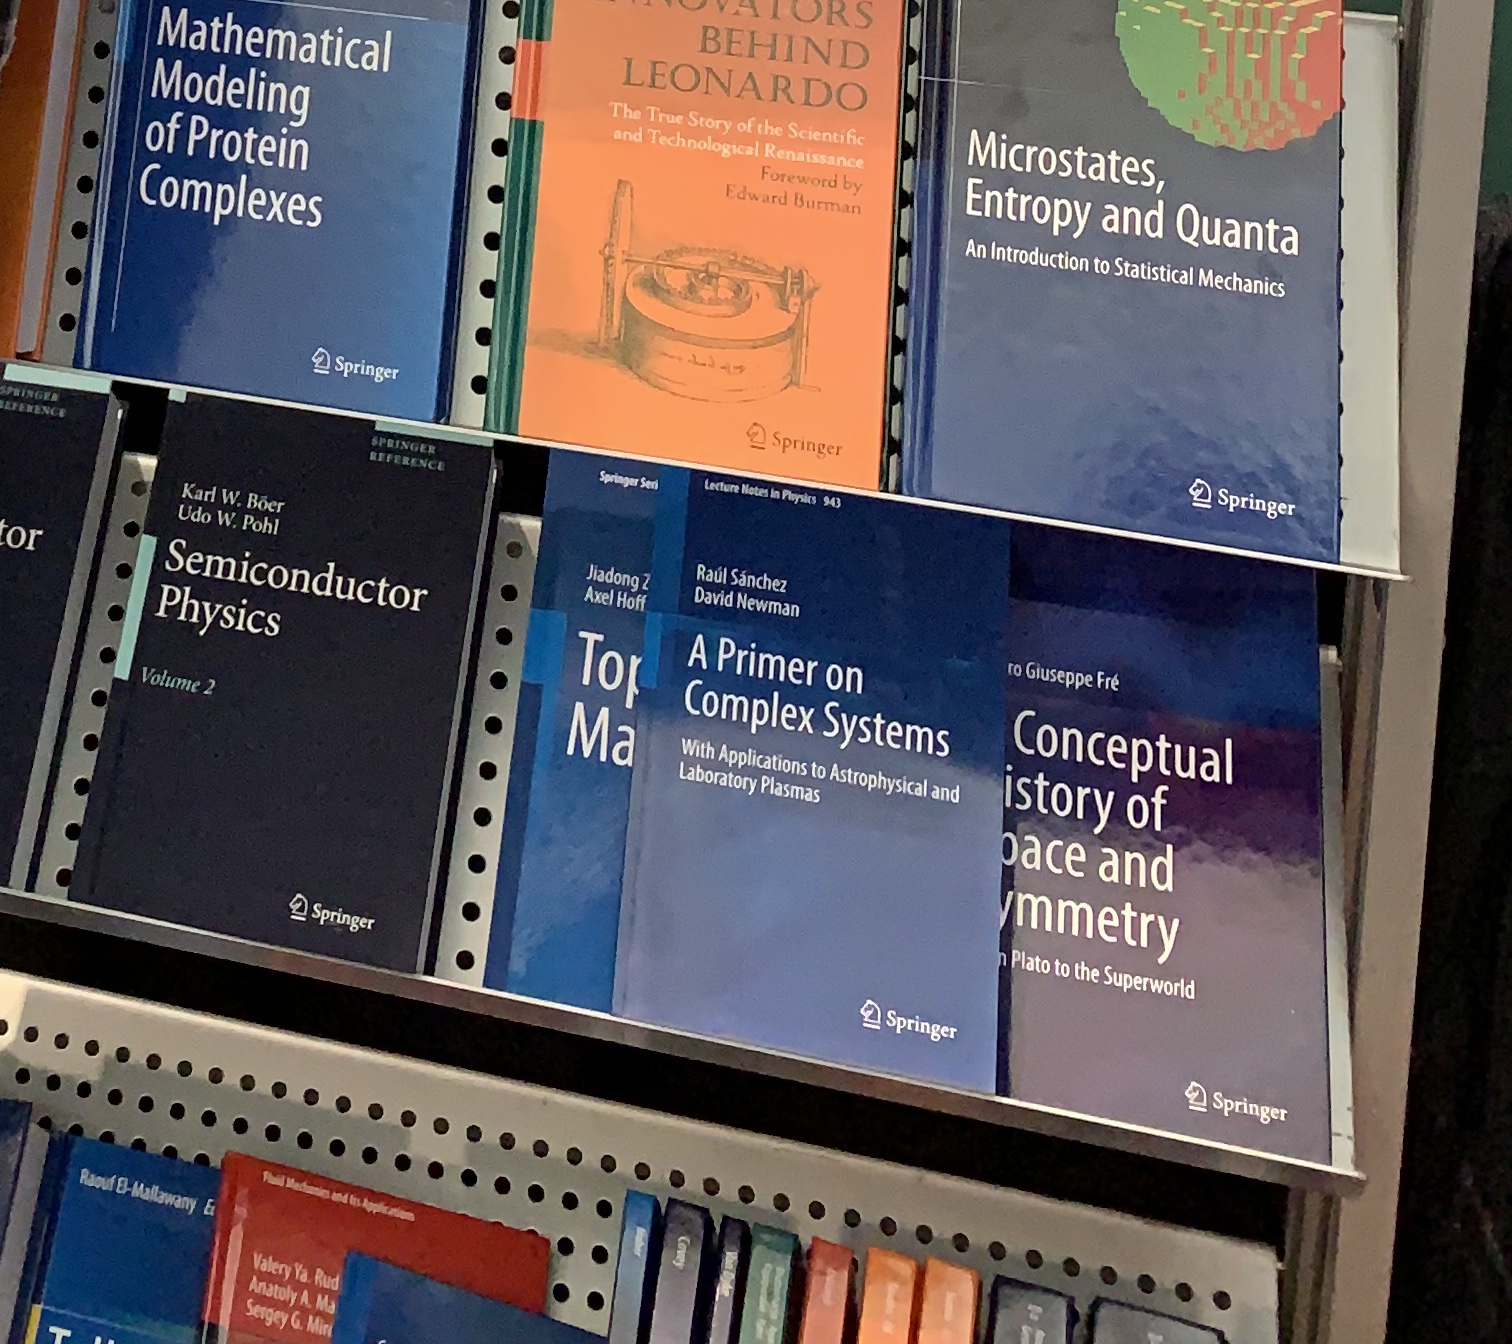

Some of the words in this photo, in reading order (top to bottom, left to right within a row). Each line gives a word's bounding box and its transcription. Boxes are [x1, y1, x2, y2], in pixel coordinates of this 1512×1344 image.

[156, 5, 392, 73] Mathematical
[699, 24, 871, 71] BEHIND
[150, 57, 311, 128] Modeling
[621, 56, 869, 112] LEONARDO
[145, 111, 184, 154] of
[187, 115, 309, 171] Protein
[608, 101, 642, 120] The
[645, 105, 684, 125] True
[687, 110, 732, 135] Story
[736, 116, 755, 135] of
[757, 119, 784, 137] the
[787, 122, 866, 147] Scientific
[613, 127, 643, 143] and
[647, 128, 760, 158] Technological
[764, 142, 865, 169] Renaissance
[967, 128, 1166, 195] Microstates,
[139, 163, 324, 228] Complexes
[725, 183, 788, 206] Edward
[793, 190, 862, 215] Burman
[760, 165, 838, 190] Foreword
[842, 174, 863, 195] by
[965, 177, 1092, 239] Entropy
[1101, 198, 1165, 239] and
[1175, 202, 1300, 256] Quanta
[965, 238, 988, 259] An
[990, 241, 1089, 273] Introduction
[1092, 255, 1111, 275] to
[1113, 256, 1195, 287] Statistical
[1197, 267, 1287, 299] Mechanics
[334, 354, 400, 383] Springer
[771, 430, 844, 458] Springer
[178, 503, 212, 524] Udo
[217, 509, 238, 530] W.
[242, 514, 280, 536] Pohl
[1217, 487, 1296, 520] Springer
[164, 537, 429, 612] Semiconductor
[586, 563, 640, 592] Jiadong
[154, 583, 282, 637] Physics
[694, 585, 734, 609] David
[736, 593, 801, 619] Newman
[687, 632, 709, 671] A
[716, 635, 820, 688] Primer
[824, 660, 865, 696] on
[1025, 660, 1094, 690] Giuseppe
[1096, 670, 1121, 693] Fré
[683, 679, 816, 735] Complex
[822, 700, 951, 759] Systems
[680, 736, 715, 761] With
[717, 744, 809, 778] Applications
[810, 760, 828, 781] to
[829, 762, 929, 800] Astrophysical
[930, 783, 962, 805] and
[1012, 709, 1234, 786] Conceptual
[678, 762, 759, 797] Laboratory
[760, 776, 822, 804] Plasmas
[311, 900, 376, 932] Springer
[1010, 949, 1052, 976] Plato
[1054, 958, 1072, 979] to
[1073, 961, 1101, 985] the
[1103, 964, 1197, 1001] Superworld
[885, 1008, 959, 1042] Springer
[1211, 1091, 1289, 1124] Springer
